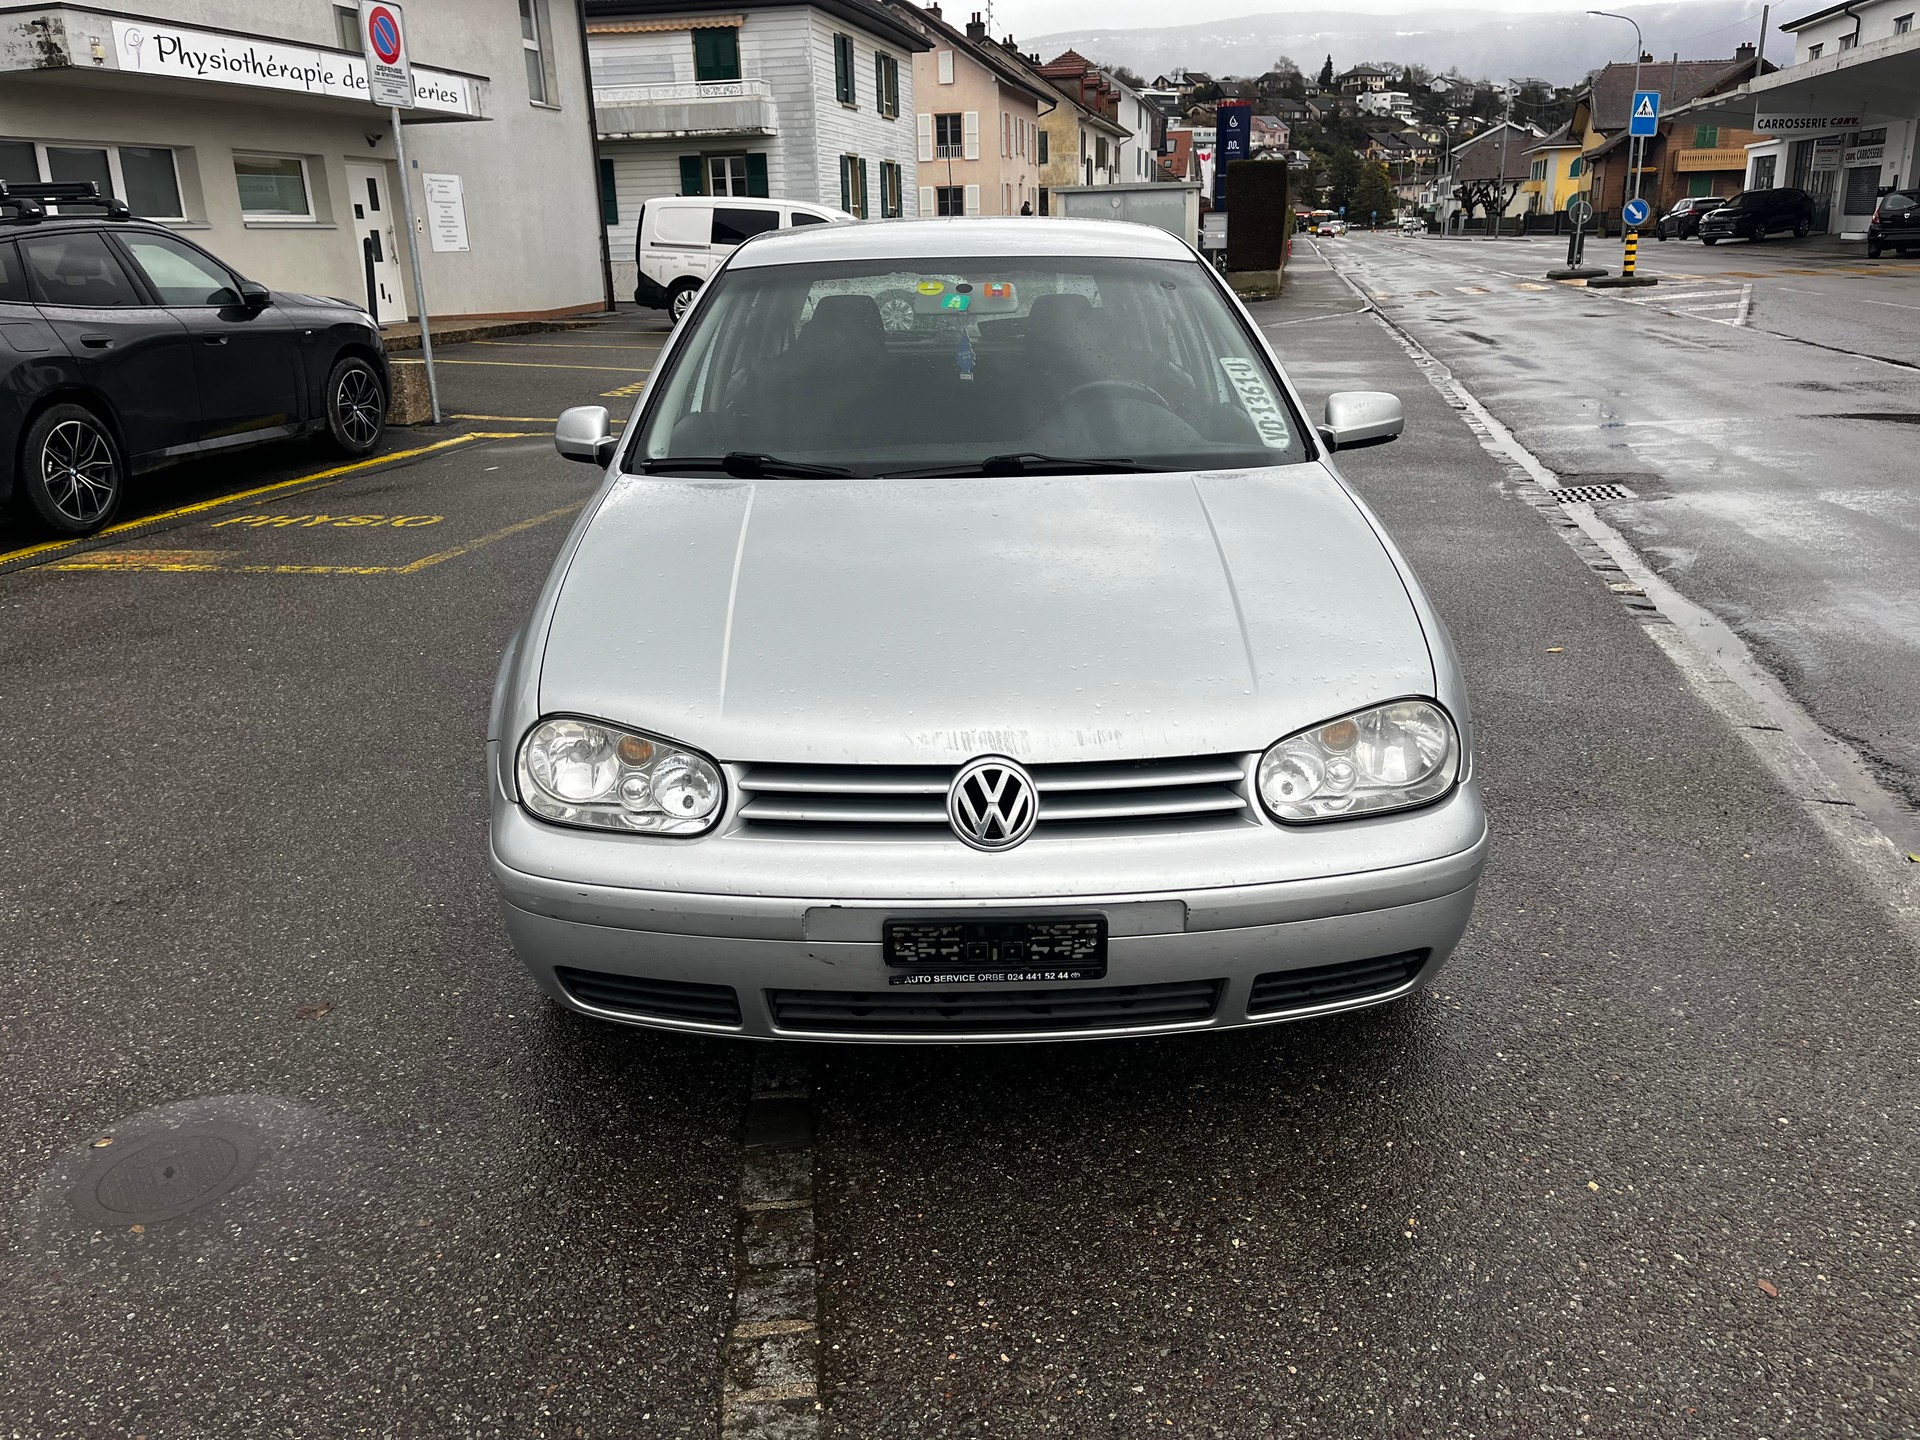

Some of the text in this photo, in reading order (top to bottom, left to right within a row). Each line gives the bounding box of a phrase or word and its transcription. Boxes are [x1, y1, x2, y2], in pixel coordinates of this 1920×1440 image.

[153, 34, 336, 90] Physiothérapie
[1757, 118, 1828, 129] CARROSSERIE
[211, 514, 444, 528] PHYSIO
[904, 971, 1069, 984] AUTO SERVICE ORBE 024 441 52 44
